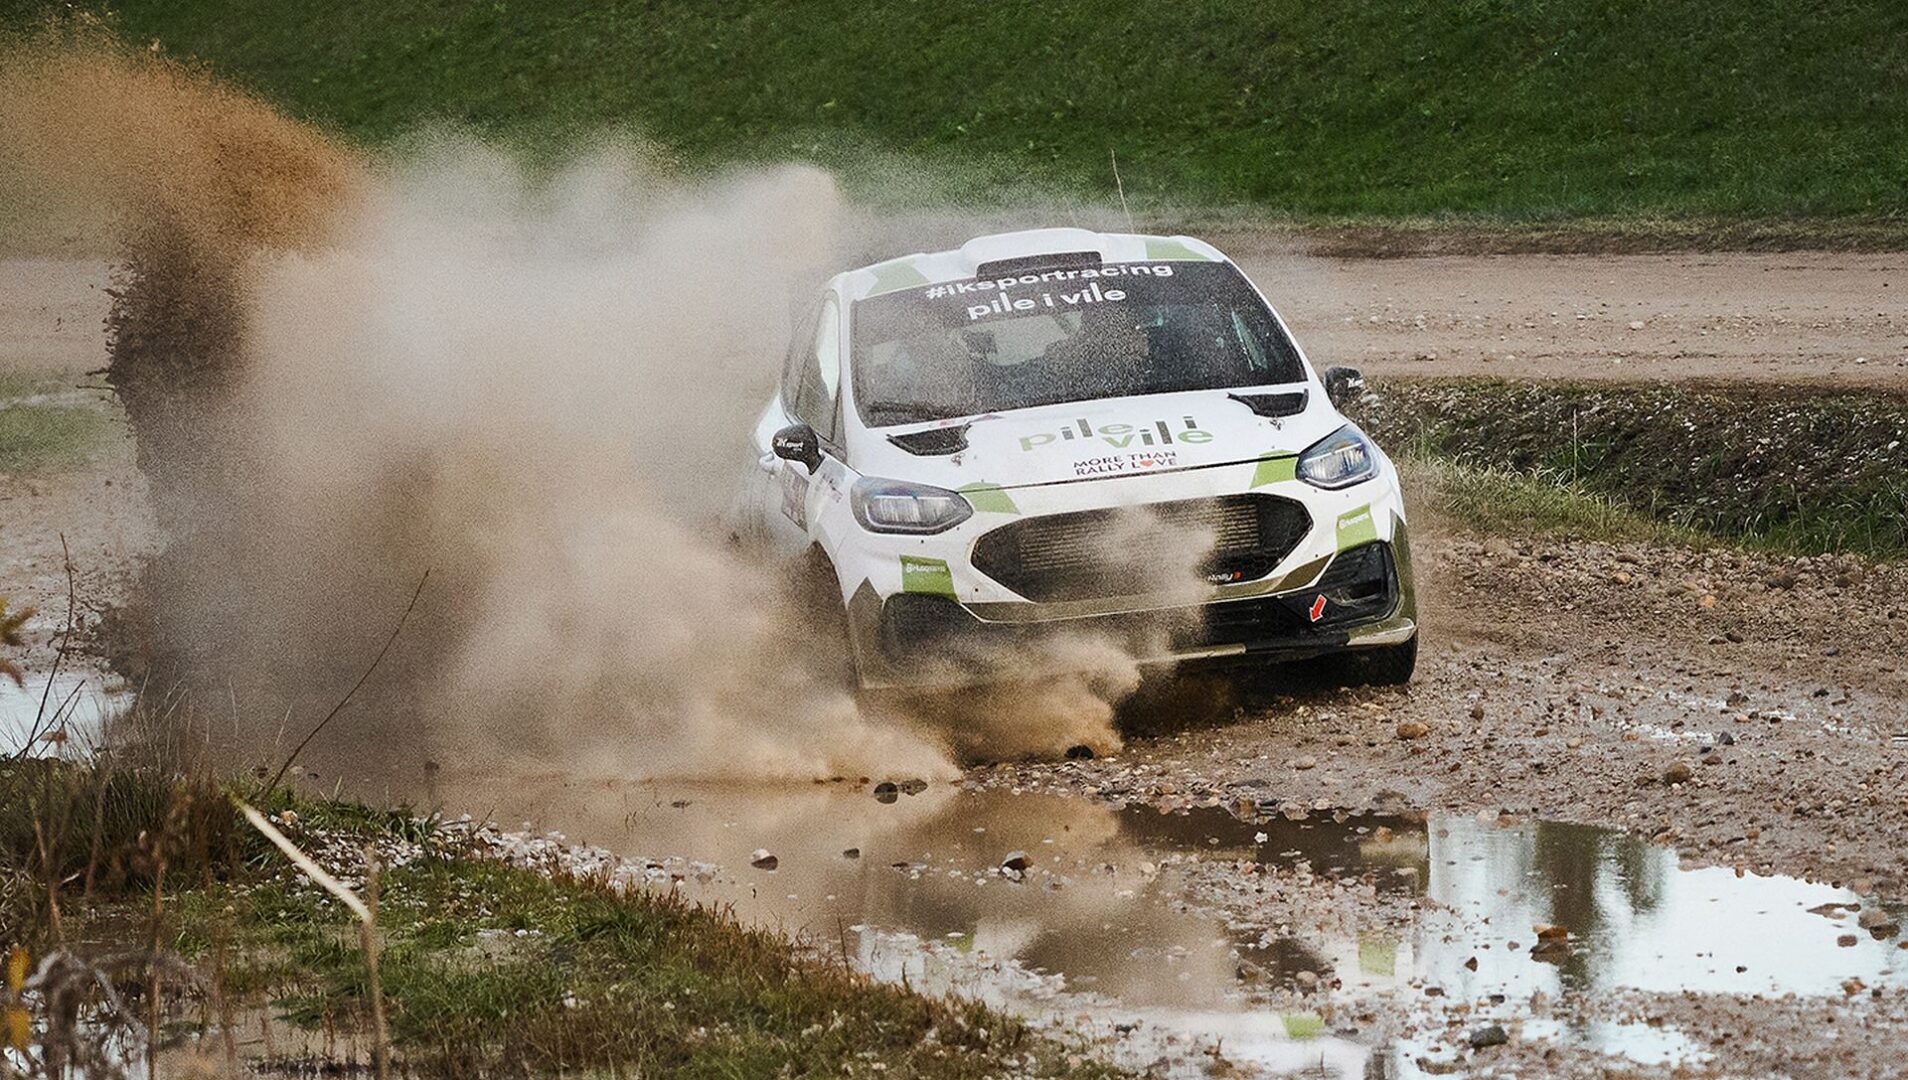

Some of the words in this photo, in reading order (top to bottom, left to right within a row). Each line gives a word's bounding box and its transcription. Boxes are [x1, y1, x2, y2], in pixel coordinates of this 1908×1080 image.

[925, 264, 1174, 299] #iksportracing
[967, 292, 1035, 320] pile
[1044, 293, 1054, 307] i
[1060, 282, 1126, 306] vile
[1018, 418, 1134, 452] pile
[1101, 420, 1214, 449] vile
[1073, 454, 1123, 468] MORE
[1128, 450, 1178, 463] THAN
[1075, 462, 1125, 476] RALLY
